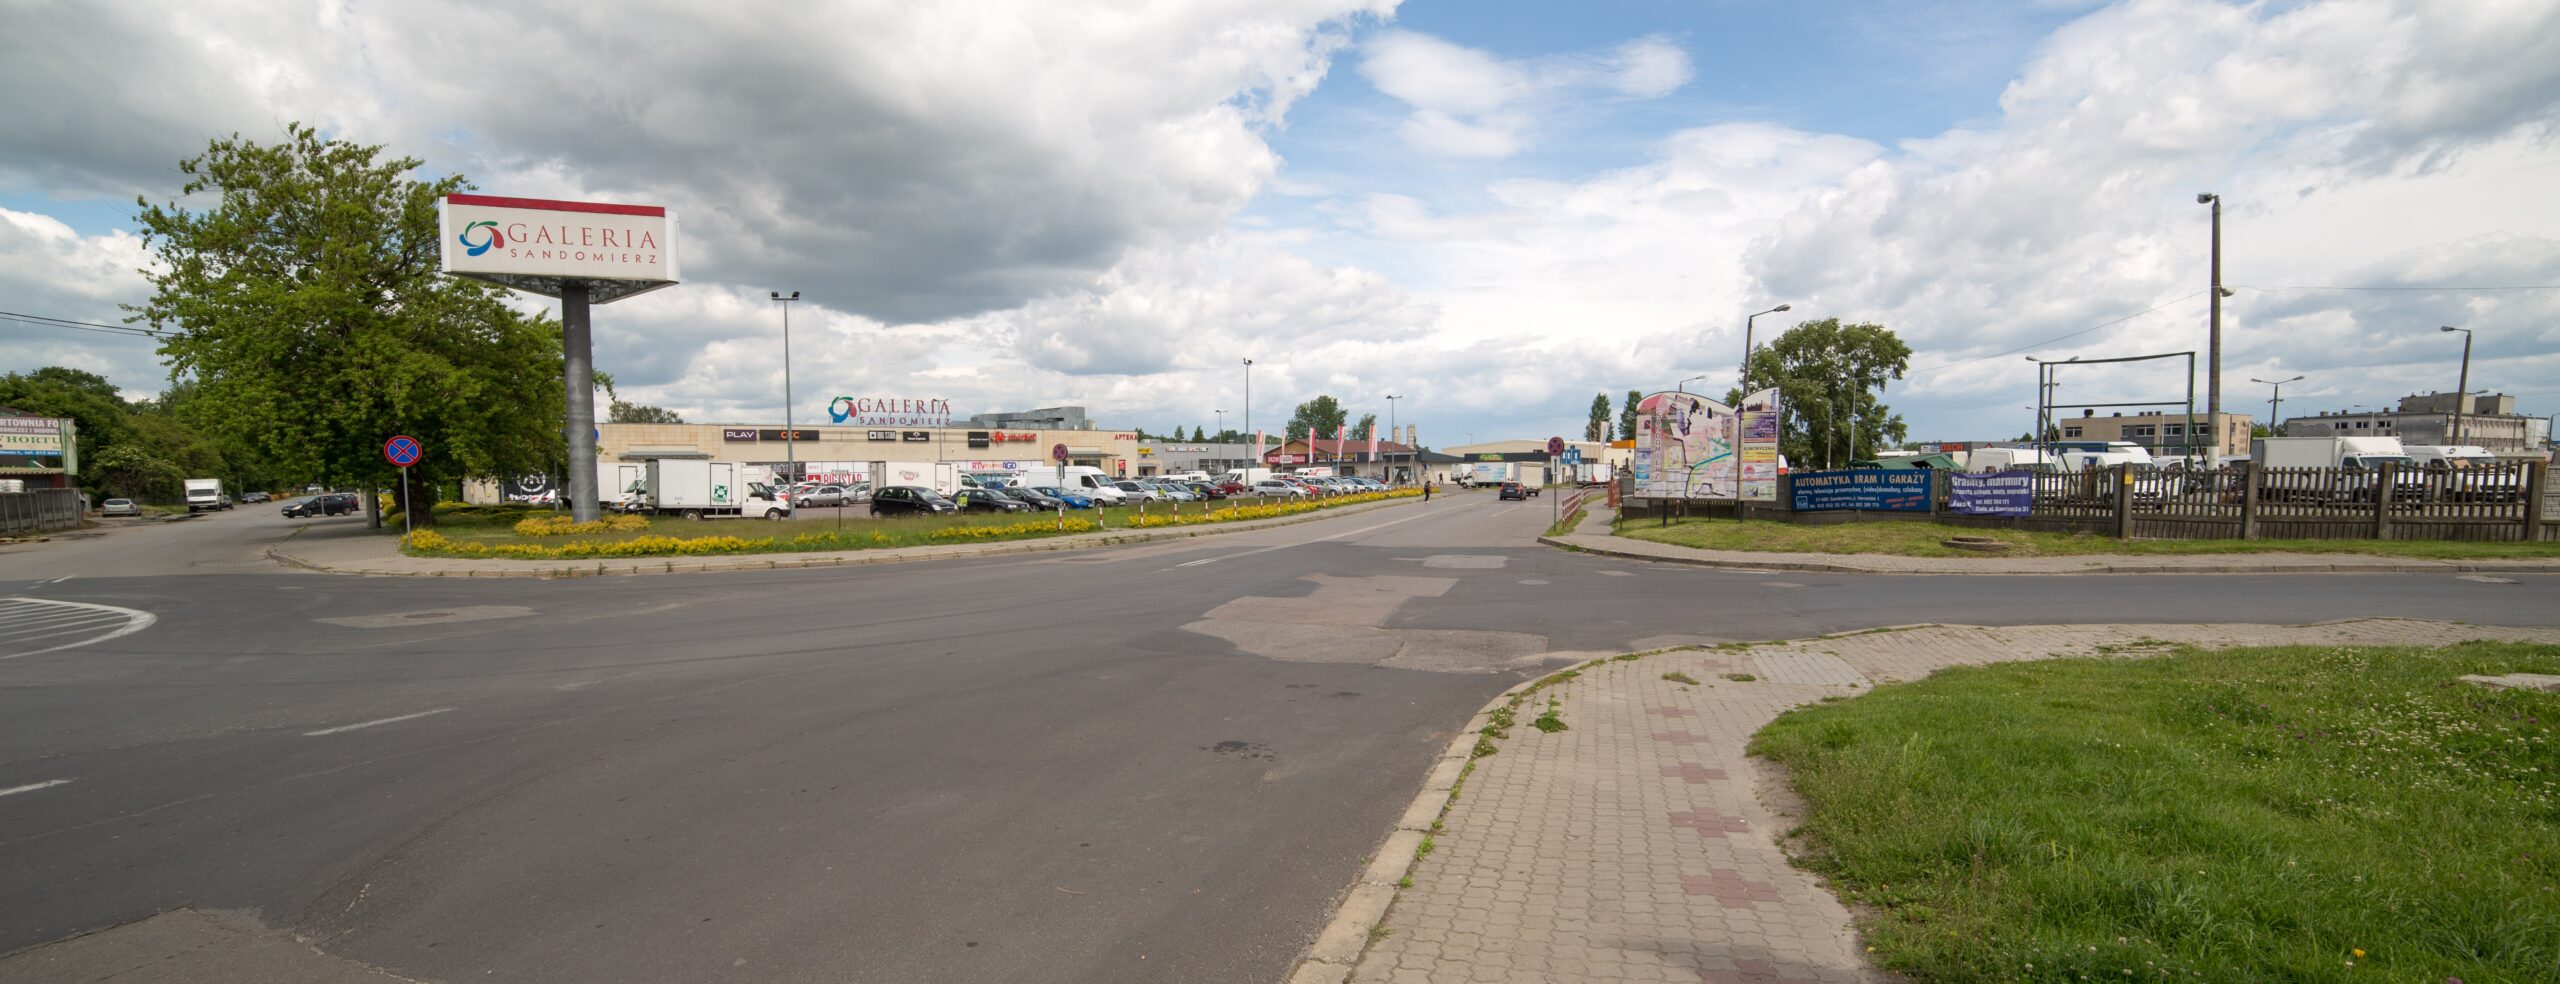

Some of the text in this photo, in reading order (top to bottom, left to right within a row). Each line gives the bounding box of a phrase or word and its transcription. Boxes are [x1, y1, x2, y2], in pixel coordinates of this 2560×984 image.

[508, 223, 657, 249] GALERIA
[510, 248, 657, 264] SANDOMIERZ
[858, 398, 950, 415] GALERIA
[860, 416, 951, 425] SANDOMIERZ
[972, 462, 984, 470] RTV
[824, 474, 862, 484] BIG STAR
[1795, 472, 1925, 487] AUTOMATYKA BRAM I GARAŻY
[1952, 476, 2029, 487] Granity, marmury
